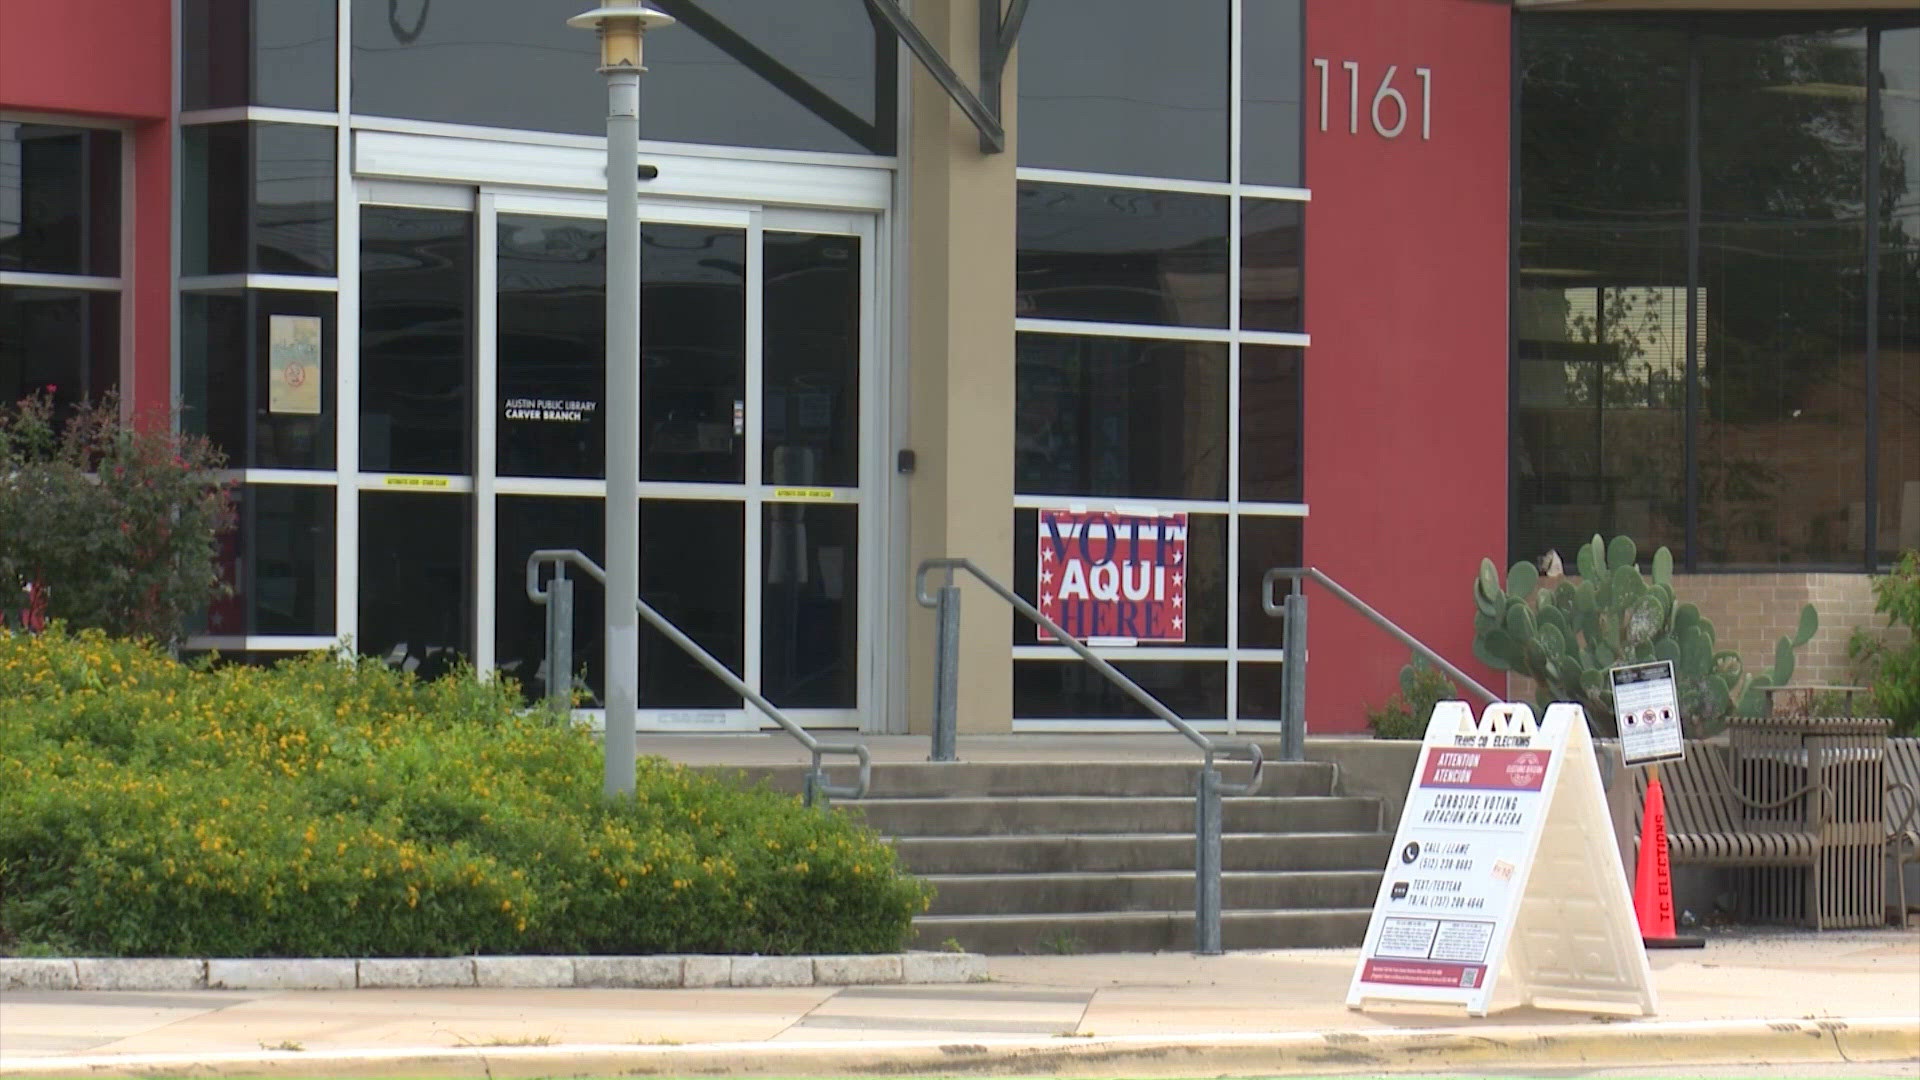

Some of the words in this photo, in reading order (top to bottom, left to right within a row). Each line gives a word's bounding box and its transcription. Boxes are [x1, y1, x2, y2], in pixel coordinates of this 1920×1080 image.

[1313, 58, 1431, 140] 1161
[505, 399, 536, 409] AUSTIN
[537, 400, 564, 410] PUBLIC
[566, 401, 597, 411] LIBRARY
[505, 409, 541, 419] CARVER
[543, 410, 581, 421] BRANCH
[1044, 514, 1184, 567] VOTE
[1058, 559, 1165, 604] AQUI
[1060, 599, 1165, 638] HERE
[1493, 735, 1531, 747] ELECTIONS
[1437, 752, 1481, 768] ATTENTION
[1434, 794, 1480, 810] CURBSIDE
[1483, 795, 1518, 811] VOTING
[1466, 811, 1479, 824] EN
[1480, 812, 1493, 824] LA
[1494, 812, 1522, 825] ACERA
[1423, 842, 1440, 854] CALL
[1655, 814, 1669, 896] ELECTIONS
[1660, 902, 1670, 922] TC
